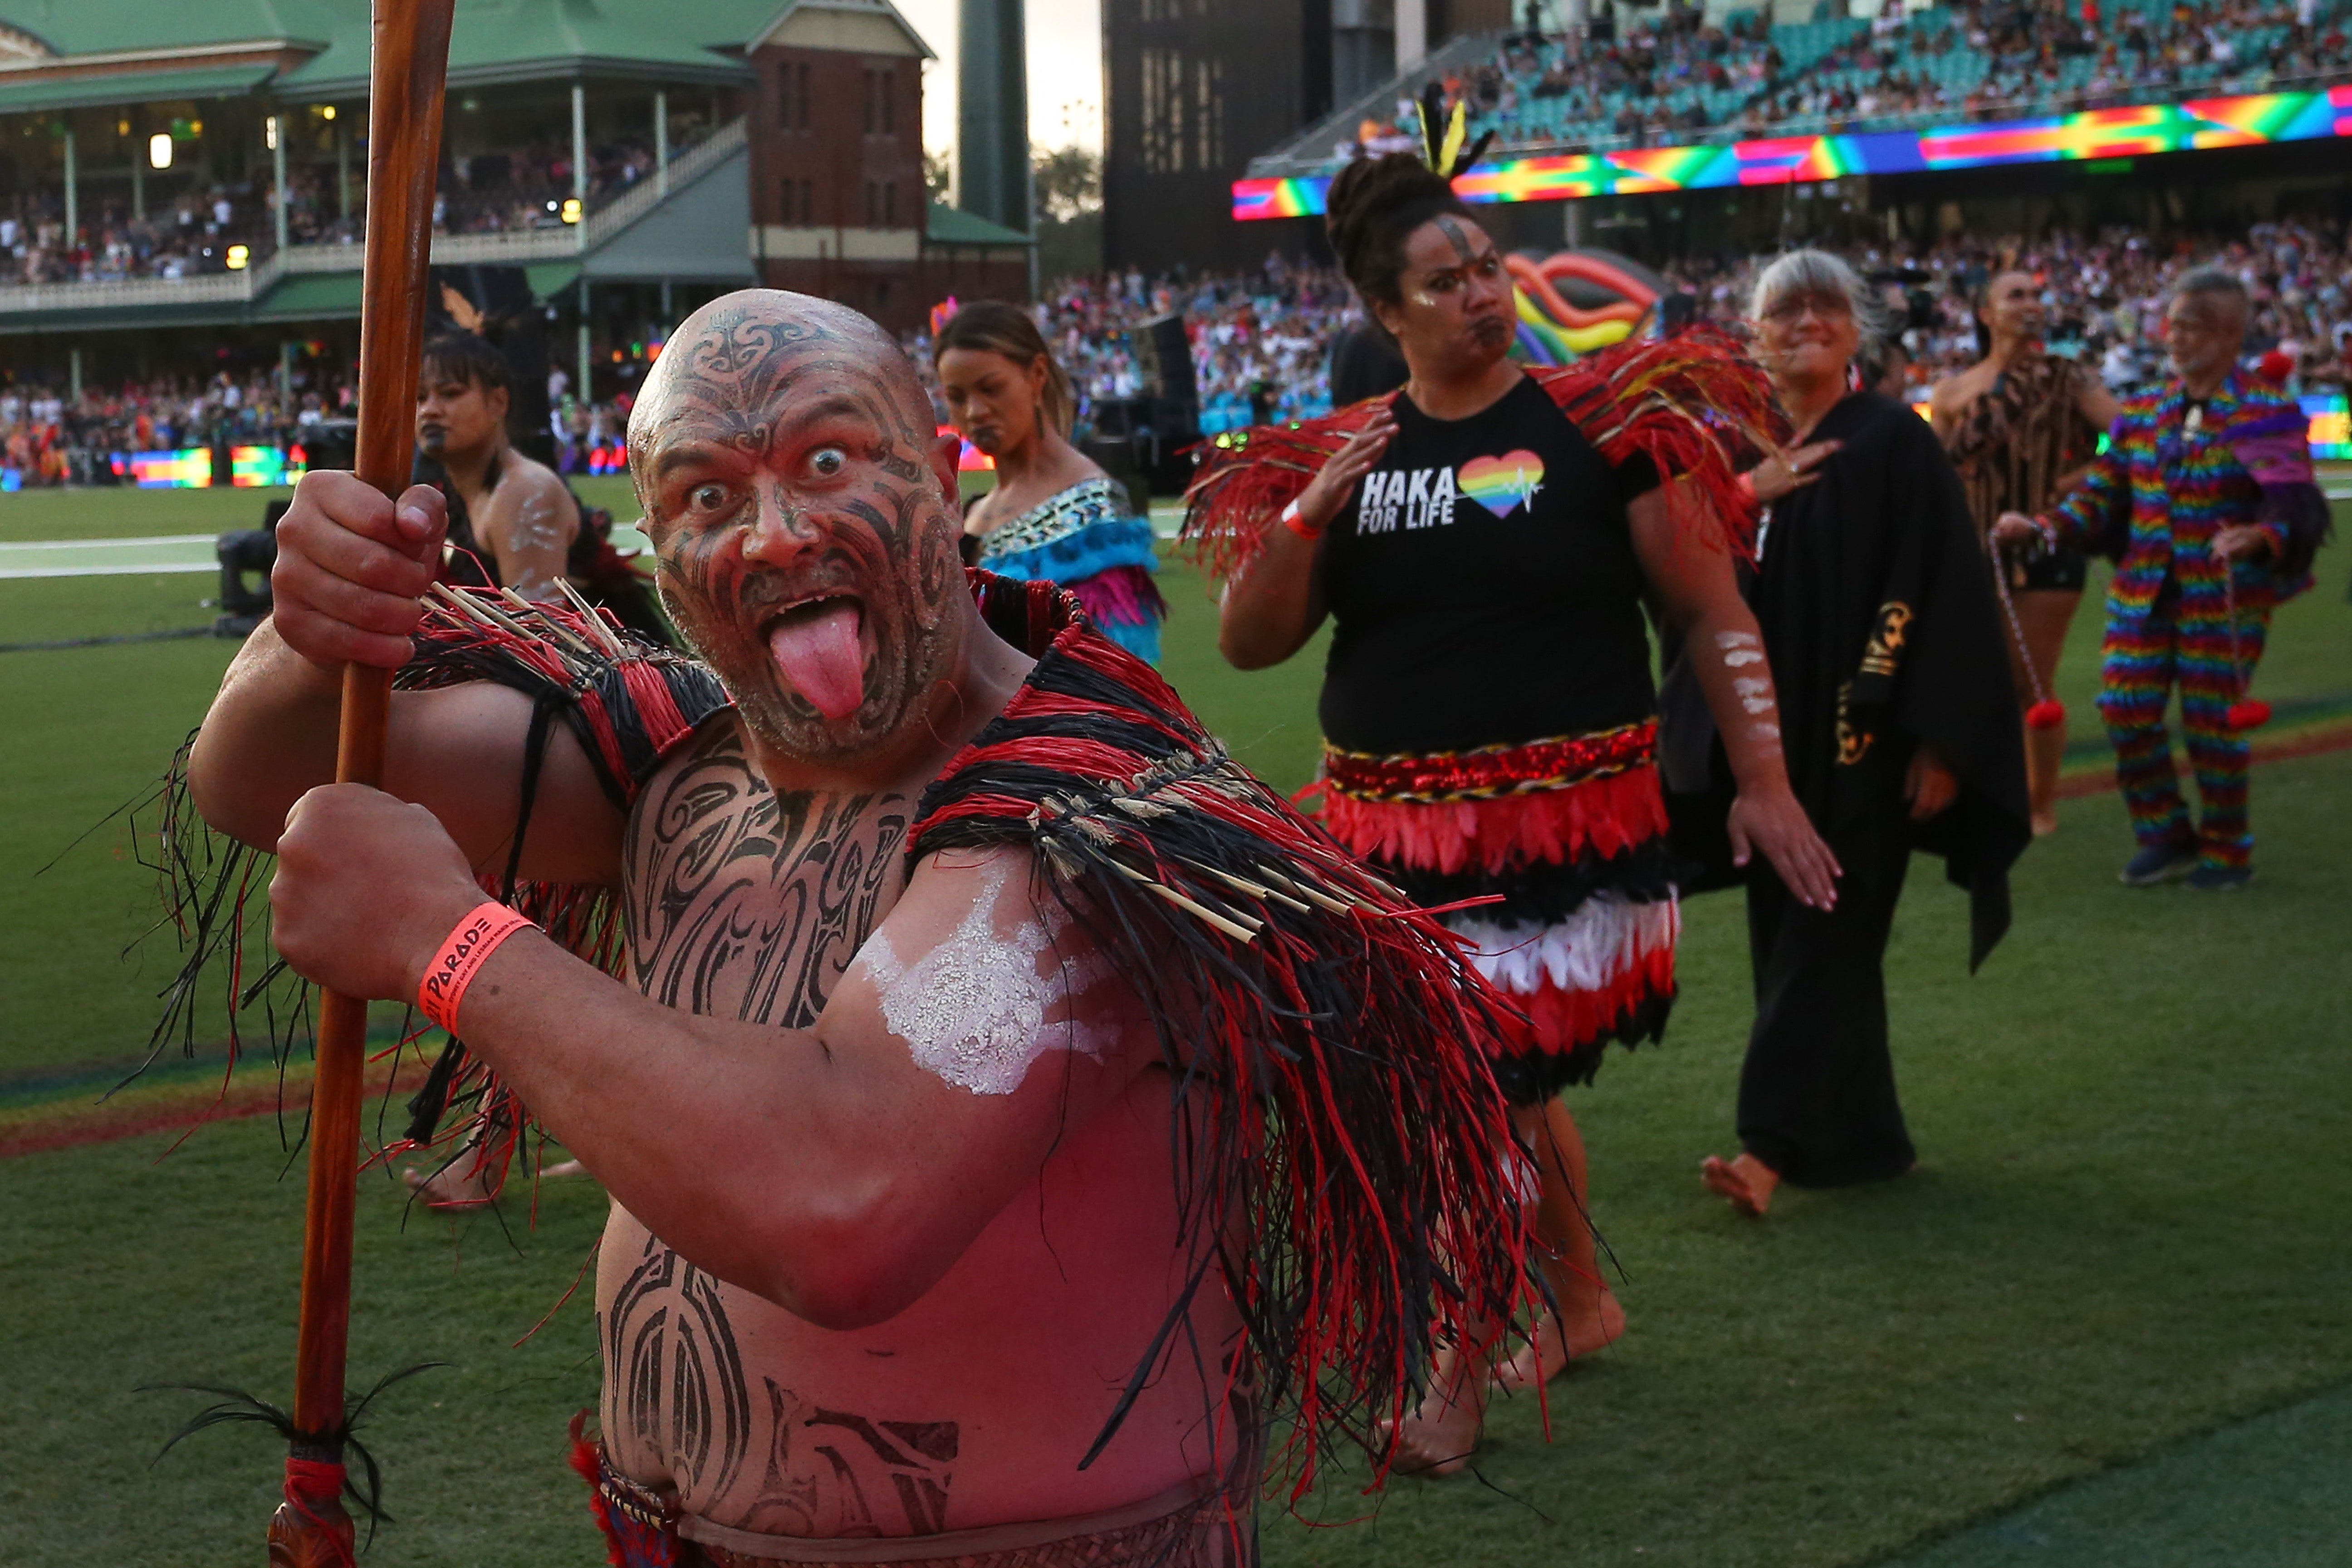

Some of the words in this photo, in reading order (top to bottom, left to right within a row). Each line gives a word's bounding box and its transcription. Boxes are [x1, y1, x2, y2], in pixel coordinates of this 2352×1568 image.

[1361, 466, 1455, 508] HAKA
[1357, 506, 1398, 537] FOR
[1406, 500, 1455, 530] LIFE
[426, 917, 492, 1001] PARADE
[459, 969, 468, 980] GAY
[467, 957, 476, 969] AND
[475, 936, 495, 957] LESBIAN
